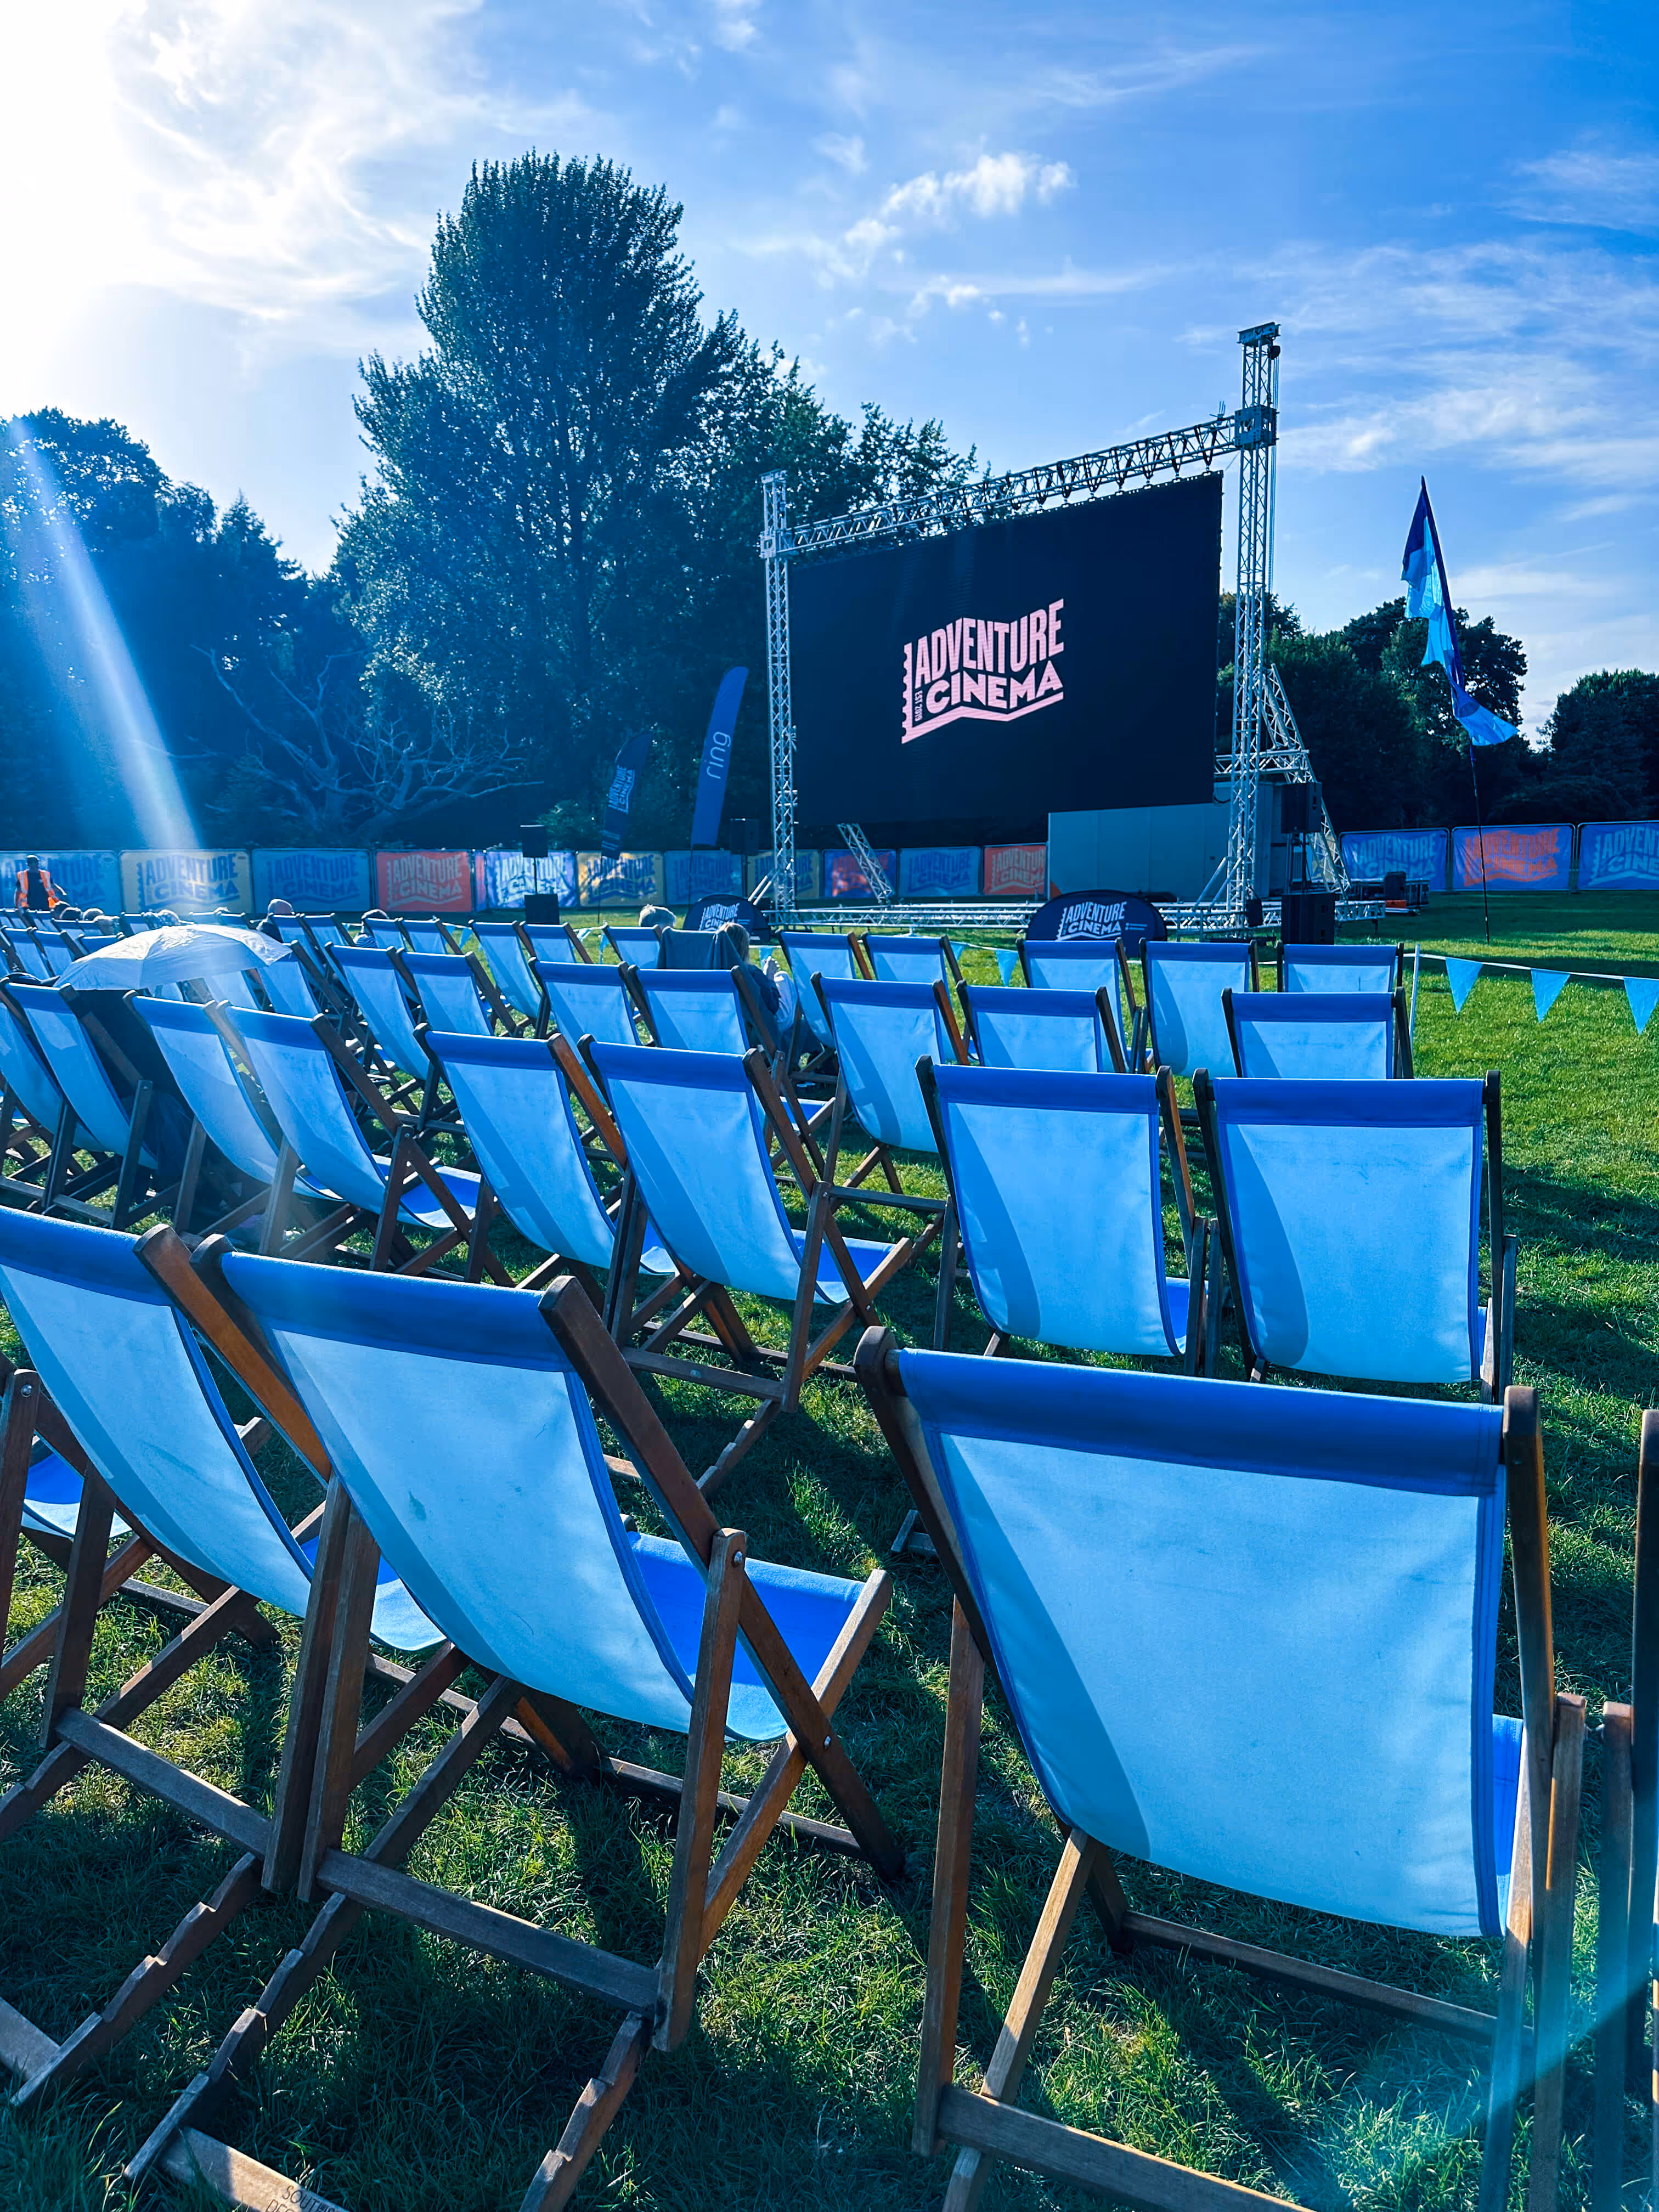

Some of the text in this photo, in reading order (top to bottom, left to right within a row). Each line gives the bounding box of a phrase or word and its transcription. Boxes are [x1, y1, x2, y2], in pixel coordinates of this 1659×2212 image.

[915, 598, 1064, 689] ADVENTURE
[926, 660, 1063, 714] CINEMA
[704, 732, 731, 779] ring
[608, 764, 627, 806] ADVENTURE
[619, 769, 633, 805] CINEMA
[1359, 833, 1437, 864] ADVENTURE
[1472, 828, 1560, 860] ADVENTURE
[1601, 826, 1659, 860] ADVEN
[146, 854, 238, 885] ADVENTURE
[275, 854, 359, 883] ADVENTURE
[393, 854, 462, 884] ADVENTURE
[913, 850, 973, 874] ADVENTURE
[997, 848, 1047, 870] ADVENTUR
[1480, 856, 1558, 878] CINEMA
[154, 879, 240, 901] CINEMA
[283, 879, 360, 899] CINEMA
[399, 879, 462, 899] CINEMA
[918, 870, 970, 885] CINEMA
[704, 903, 740, 920] ADVENTURE
[1065, 901, 1127, 924] ADVENTURE
[1068, 920, 1121, 934] CINEMA
